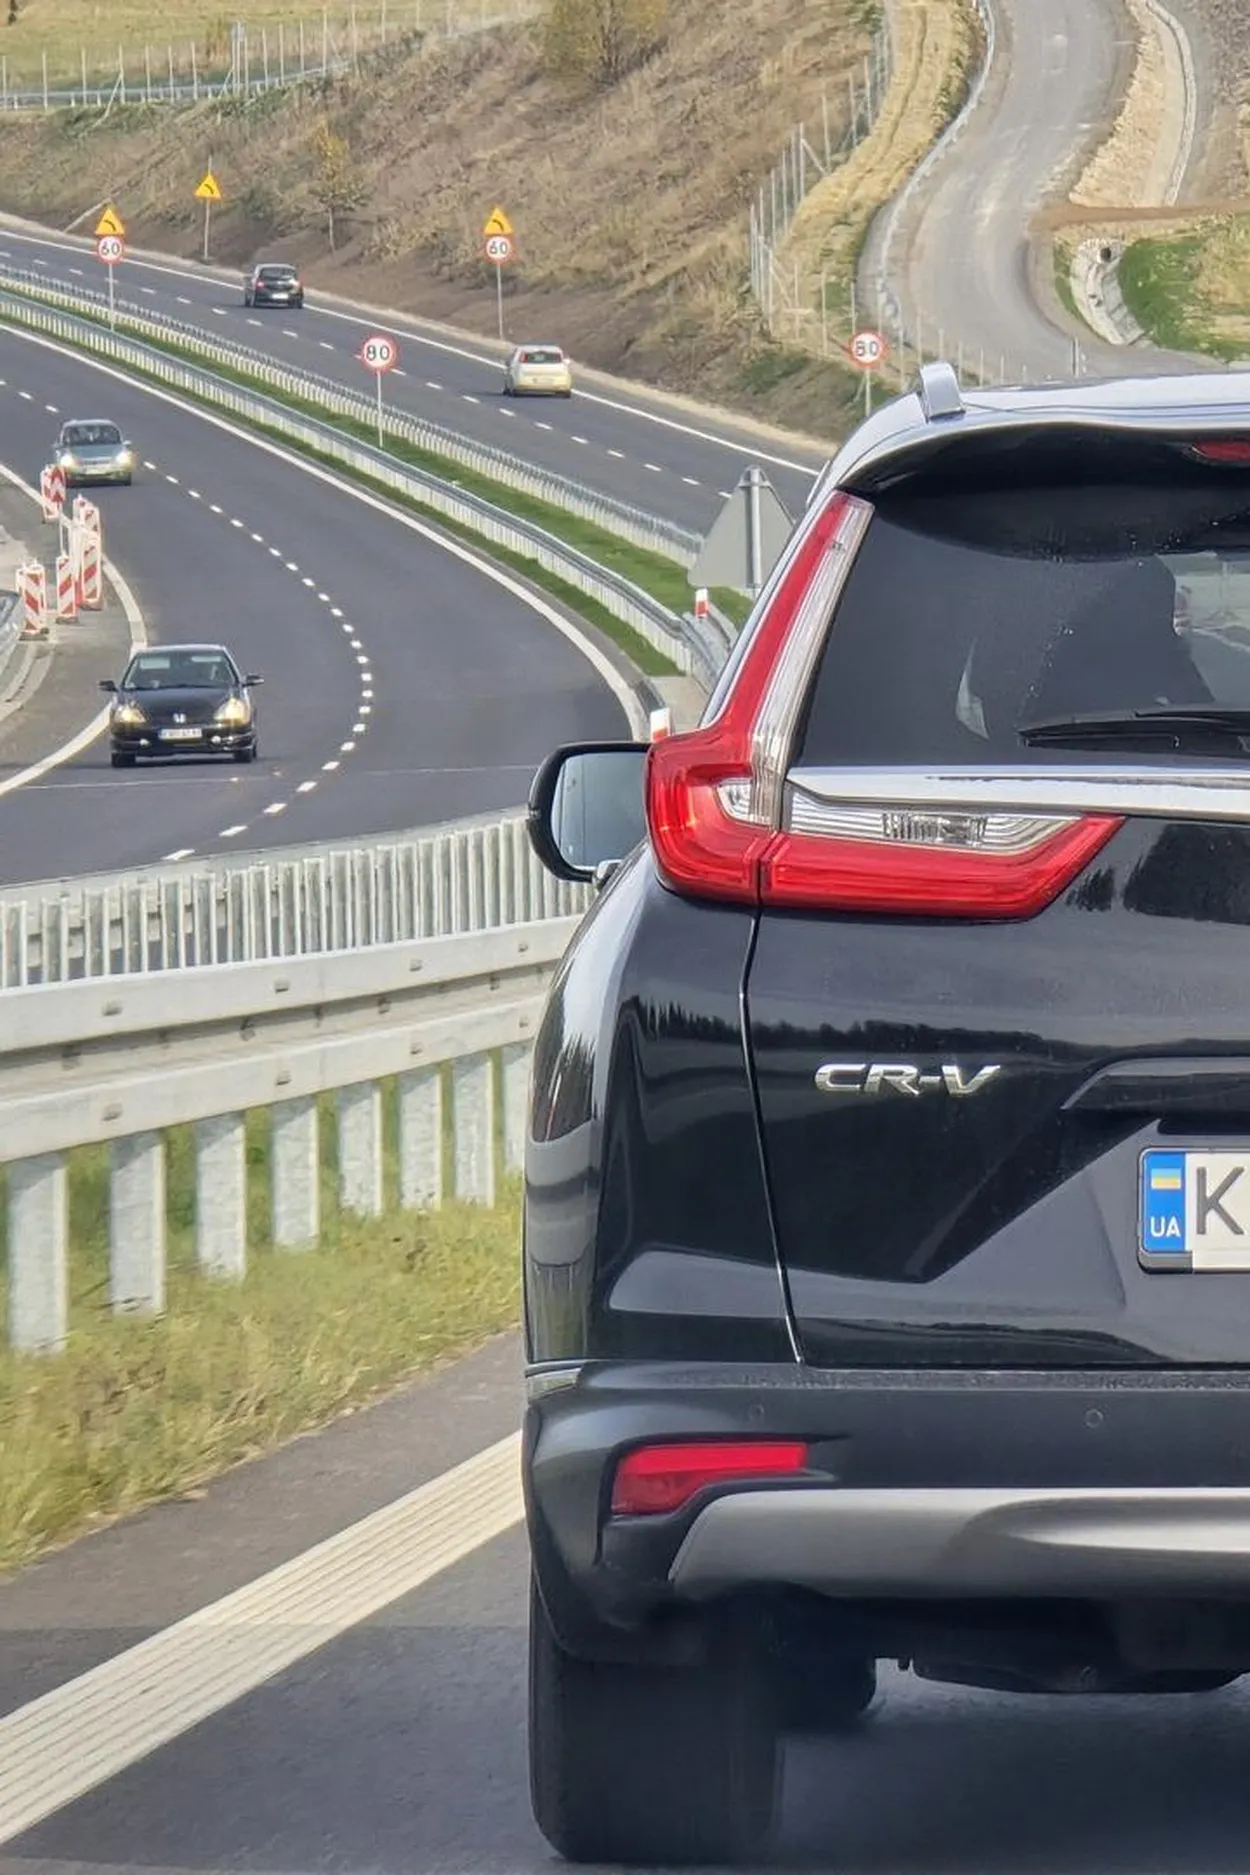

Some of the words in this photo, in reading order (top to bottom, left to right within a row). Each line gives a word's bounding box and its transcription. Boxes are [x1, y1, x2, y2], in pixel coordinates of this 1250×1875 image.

[101, 241, 120, 255] 60
[490, 240, 507, 254] 60
[366, 344, 390, 361] 80
[815, 1063, 1001, 1095] CR-V
[1150, 1216, 1181, 1237] UA
